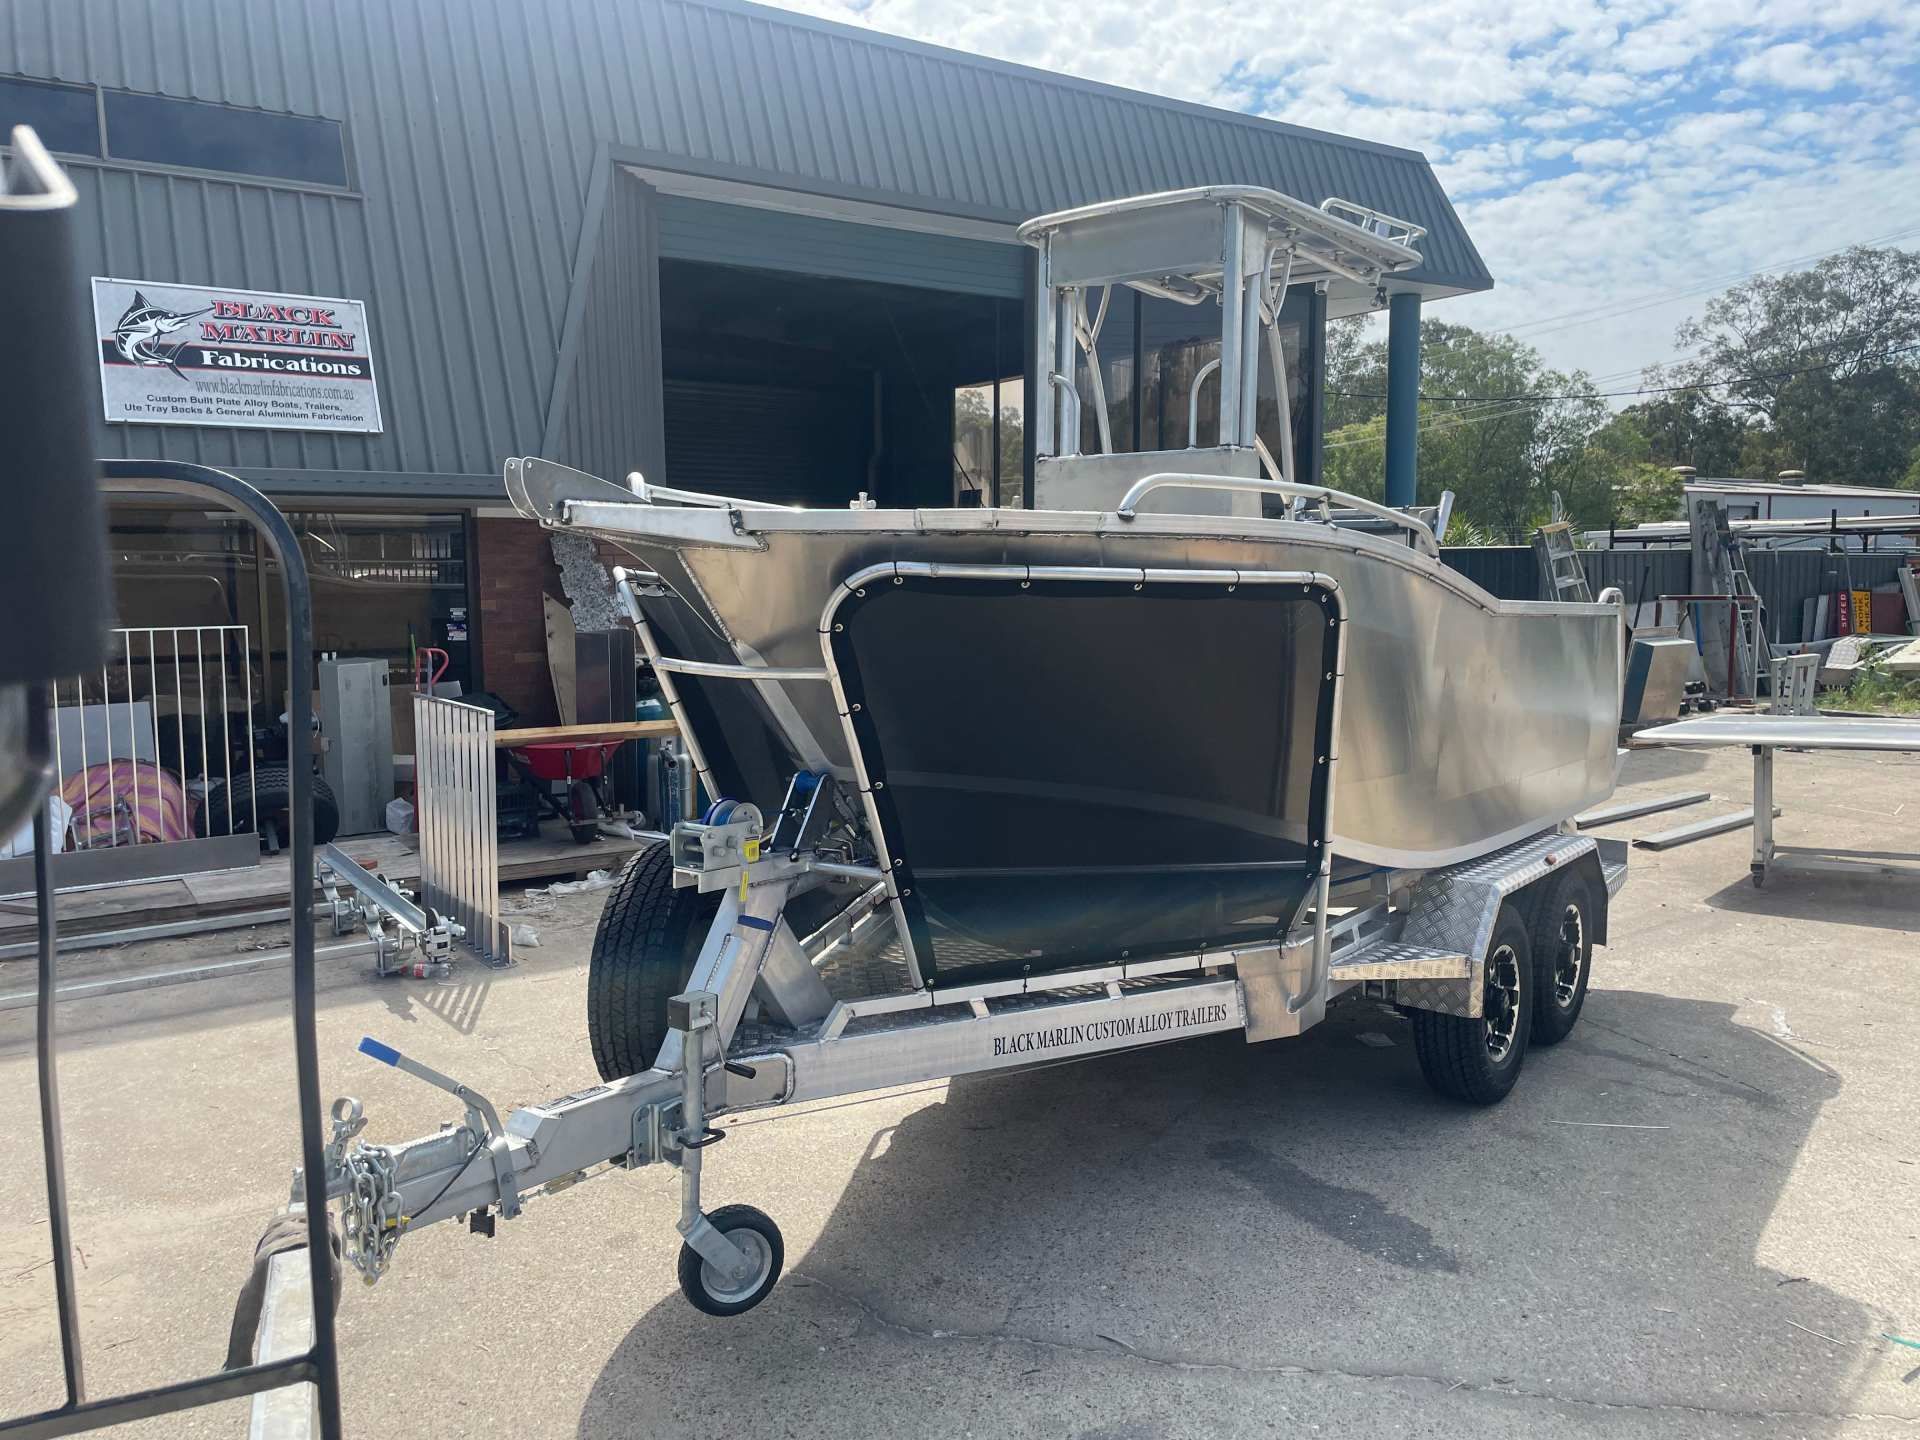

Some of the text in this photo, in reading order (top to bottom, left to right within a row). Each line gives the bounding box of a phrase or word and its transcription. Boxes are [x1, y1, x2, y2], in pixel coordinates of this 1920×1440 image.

[211, 300, 342, 329] BLACK
[199, 322, 356, 351] MARLIN
[200, 350, 361, 375] Fabrications
[195, 378, 354, 401] www.blackmarlinfabrications.com.au
[124, 403, 142, 412] Ute
[145, 404, 168, 414] Tray
[171, 406, 202, 415] Backs
[216, 408, 255, 417] General
[257, 410, 309, 419] Aluminium
[311, 412, 364, 422] Fabrication
[146, 394, 343, 412] Custom Built Plate Alloy Boats, Trailers,
[993, 1003, 1227, 1056] BLACK MARLIN CUSTOM ALLOY TRAILERS
